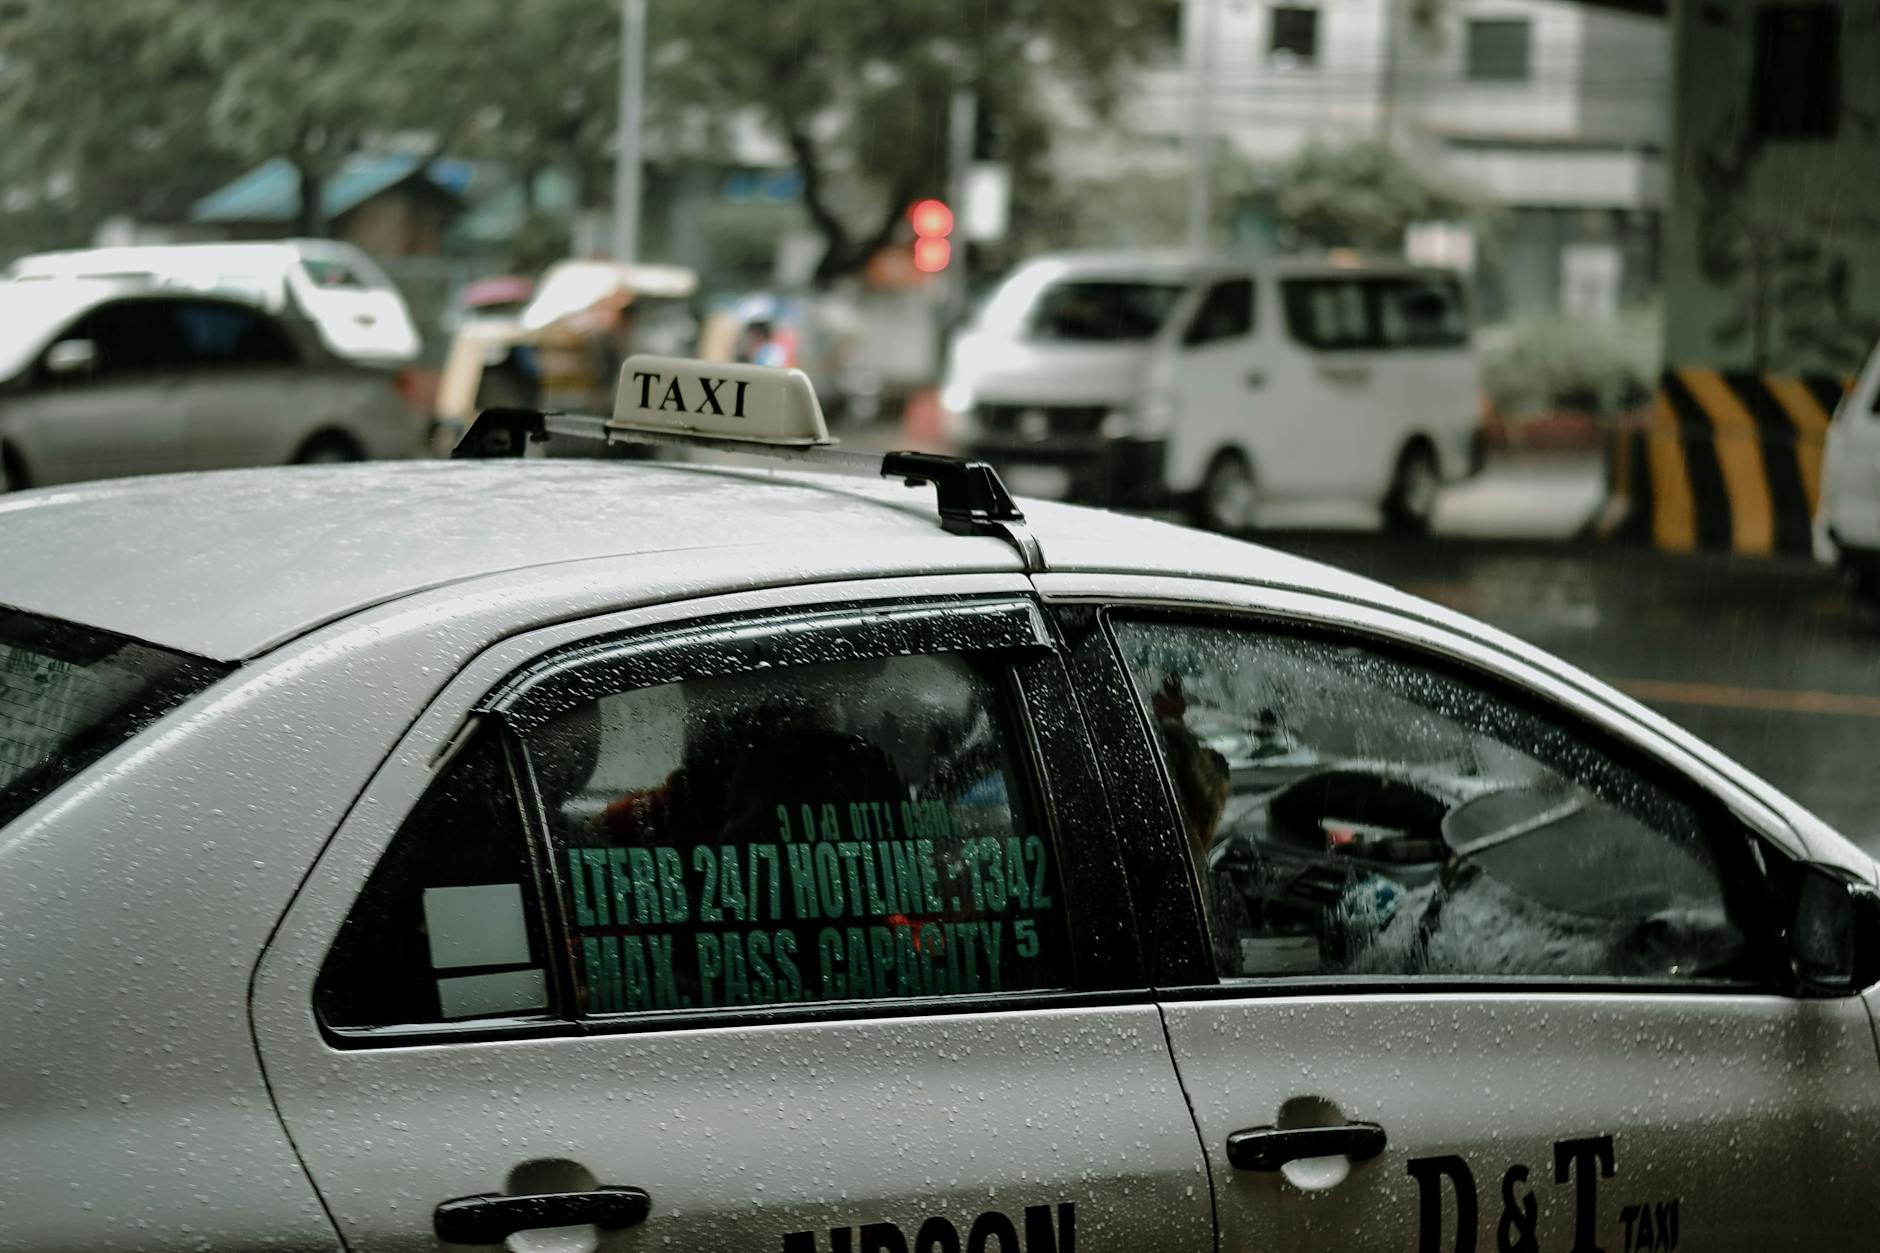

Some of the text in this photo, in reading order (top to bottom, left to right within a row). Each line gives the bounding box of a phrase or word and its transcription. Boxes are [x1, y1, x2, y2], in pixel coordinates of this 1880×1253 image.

[633, 372, 749, 417] TAXI
[568, 846, 689, 927] LTFRB
[692, 843, 782, 922] 24/7
[962, 834, 1052, 910] 1342
[695, 927, 814, 1004] PASS.
[818, 921, 1003, 999] CAPACITY
[1013, 919, 1040, 958] 5
[1618, 1199, 1681, 1253] TAXI
